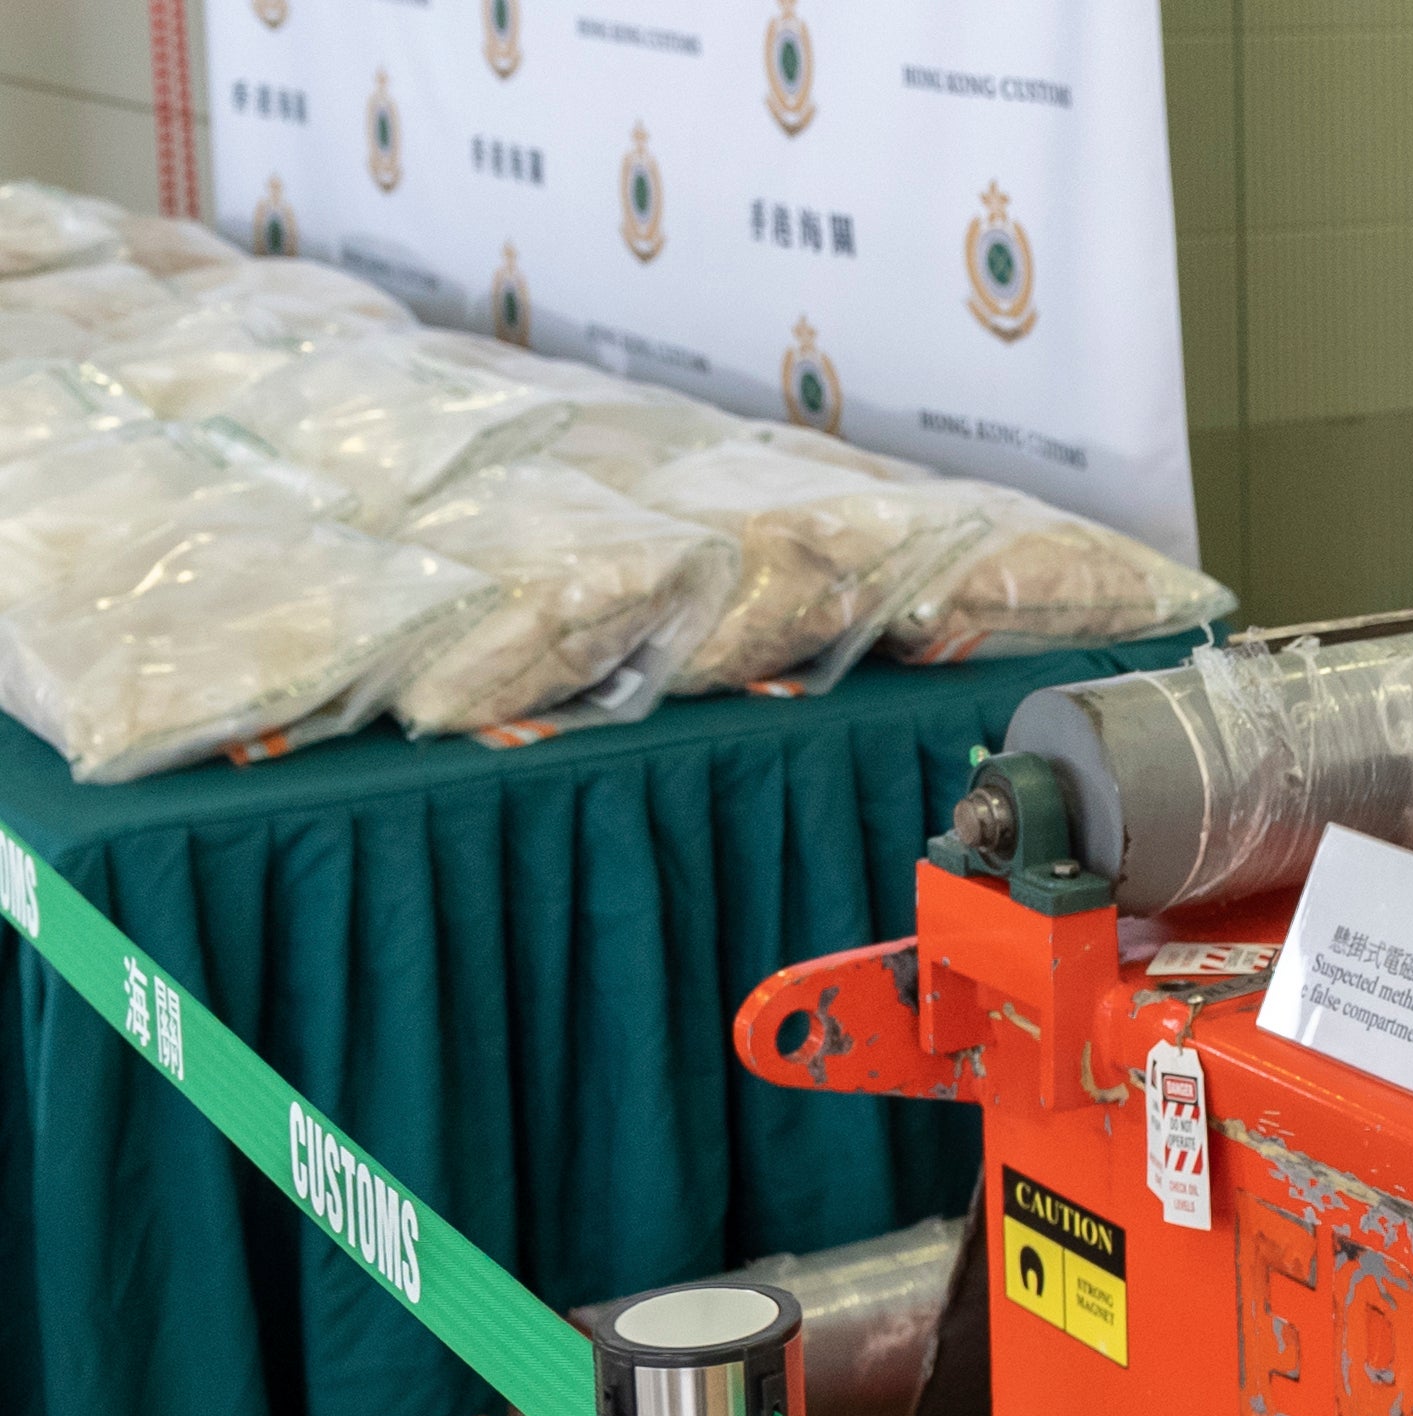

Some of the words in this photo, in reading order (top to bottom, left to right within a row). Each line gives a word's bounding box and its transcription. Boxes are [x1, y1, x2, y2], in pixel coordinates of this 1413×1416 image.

[1312, 953, 1380, 996] Suspected
[1309, 983, 1342, 1013] false
[123, 955, 184, 1081] 海關
[289, 1101, 421, 1304] CUSTOMS
[1170, 1116, 1180, 1130] DO
[1180, 1117, 1194, 1134] NOT
[1167, 1133, 1196, 1151] OPERATE
[1015, 1181, 1114, 1255] CAUTION
[1076, 1276, 1114, 1308] STRONG
[1076, 1292, 1115, 1326] MAGNET
